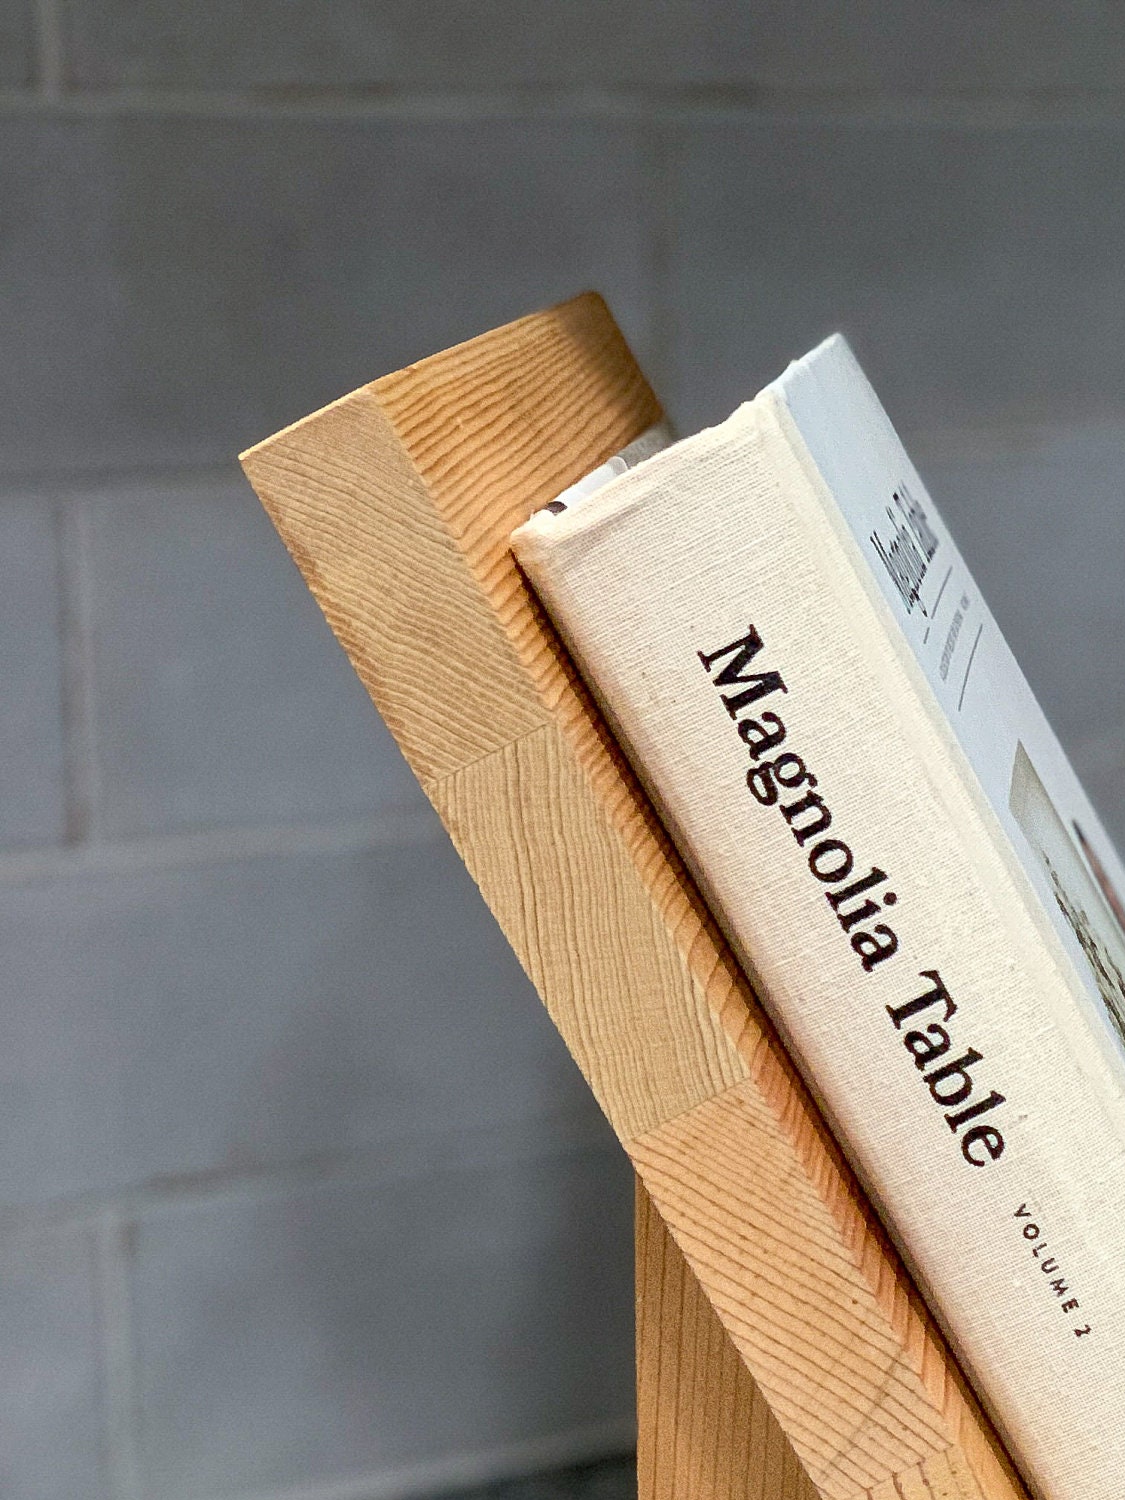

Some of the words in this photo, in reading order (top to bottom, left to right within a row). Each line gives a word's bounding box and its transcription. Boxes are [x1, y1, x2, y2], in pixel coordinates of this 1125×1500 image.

[697, 624, 900, 973] Magnolia
[886, 968, 1006, 1168] Table
[1013, 1203, 1080, 1314] VOLUME
[1073, 1324, 1092, 1338] 2
